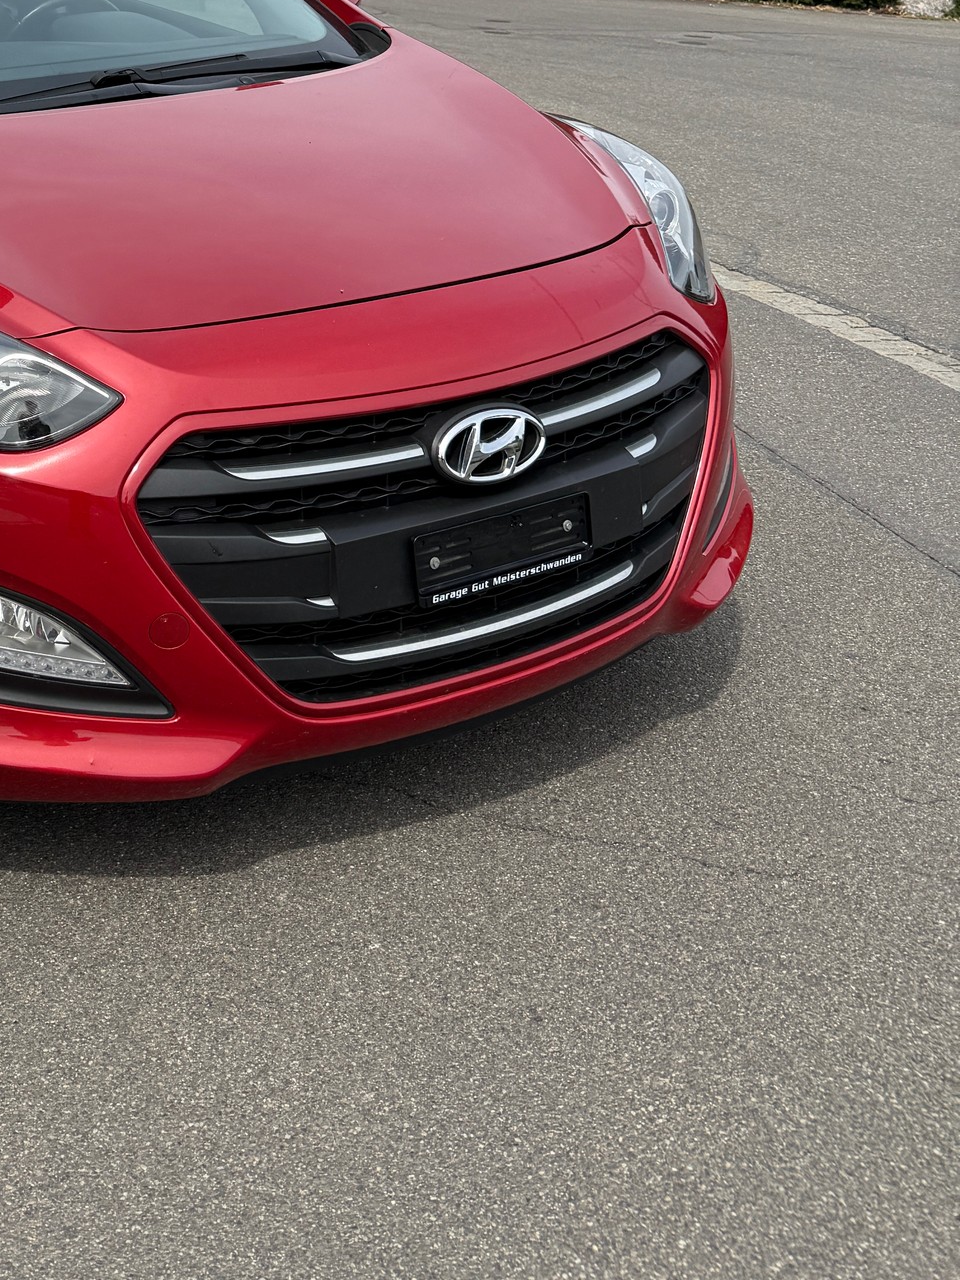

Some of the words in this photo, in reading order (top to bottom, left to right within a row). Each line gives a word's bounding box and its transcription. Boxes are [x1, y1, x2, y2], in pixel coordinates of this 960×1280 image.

[432, 588, 468, 604] Garage
[471, 580, 490, 593] Gut
[492, 553, 582, 586] Meisterschwanden
